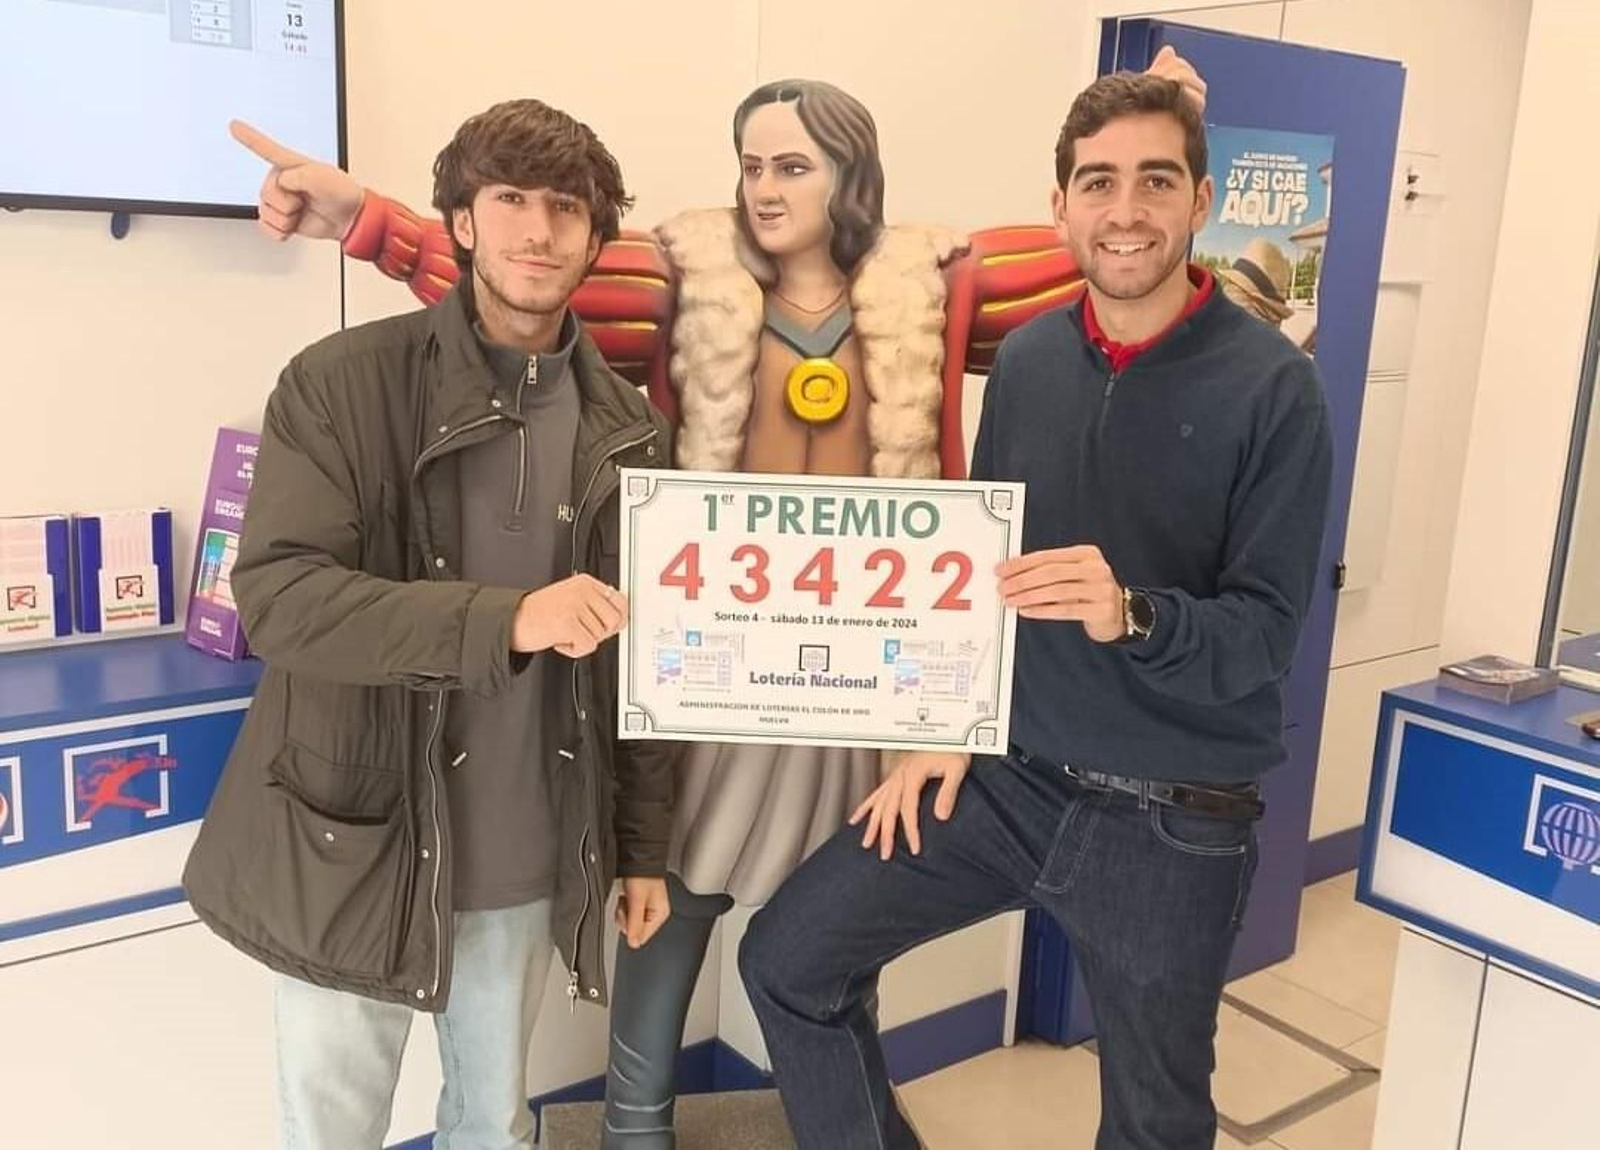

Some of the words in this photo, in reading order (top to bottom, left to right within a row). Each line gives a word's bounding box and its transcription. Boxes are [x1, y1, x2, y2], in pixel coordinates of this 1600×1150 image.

[286, 13, 303, 27] 13
[1252, 169, 1270, 191] SI
[1272, 170, 1307, 193] CAE
[746, 494, 941, 538] PREMIO
[714, 610, 750, 622] Sorteo
[751, 613, 759, 622] 4
[770, 613, 808, 625] sábado
[811, 615, 824, 625] 13
[827, 615, 840, 626] de
[842, 618, 873, 627] enero
[875, 617, 889, 628] de
[892, 618, 918, 628] 2024
[749, 671, 806, 686] Lotería
[810, 674, 878, 689] Nacional
